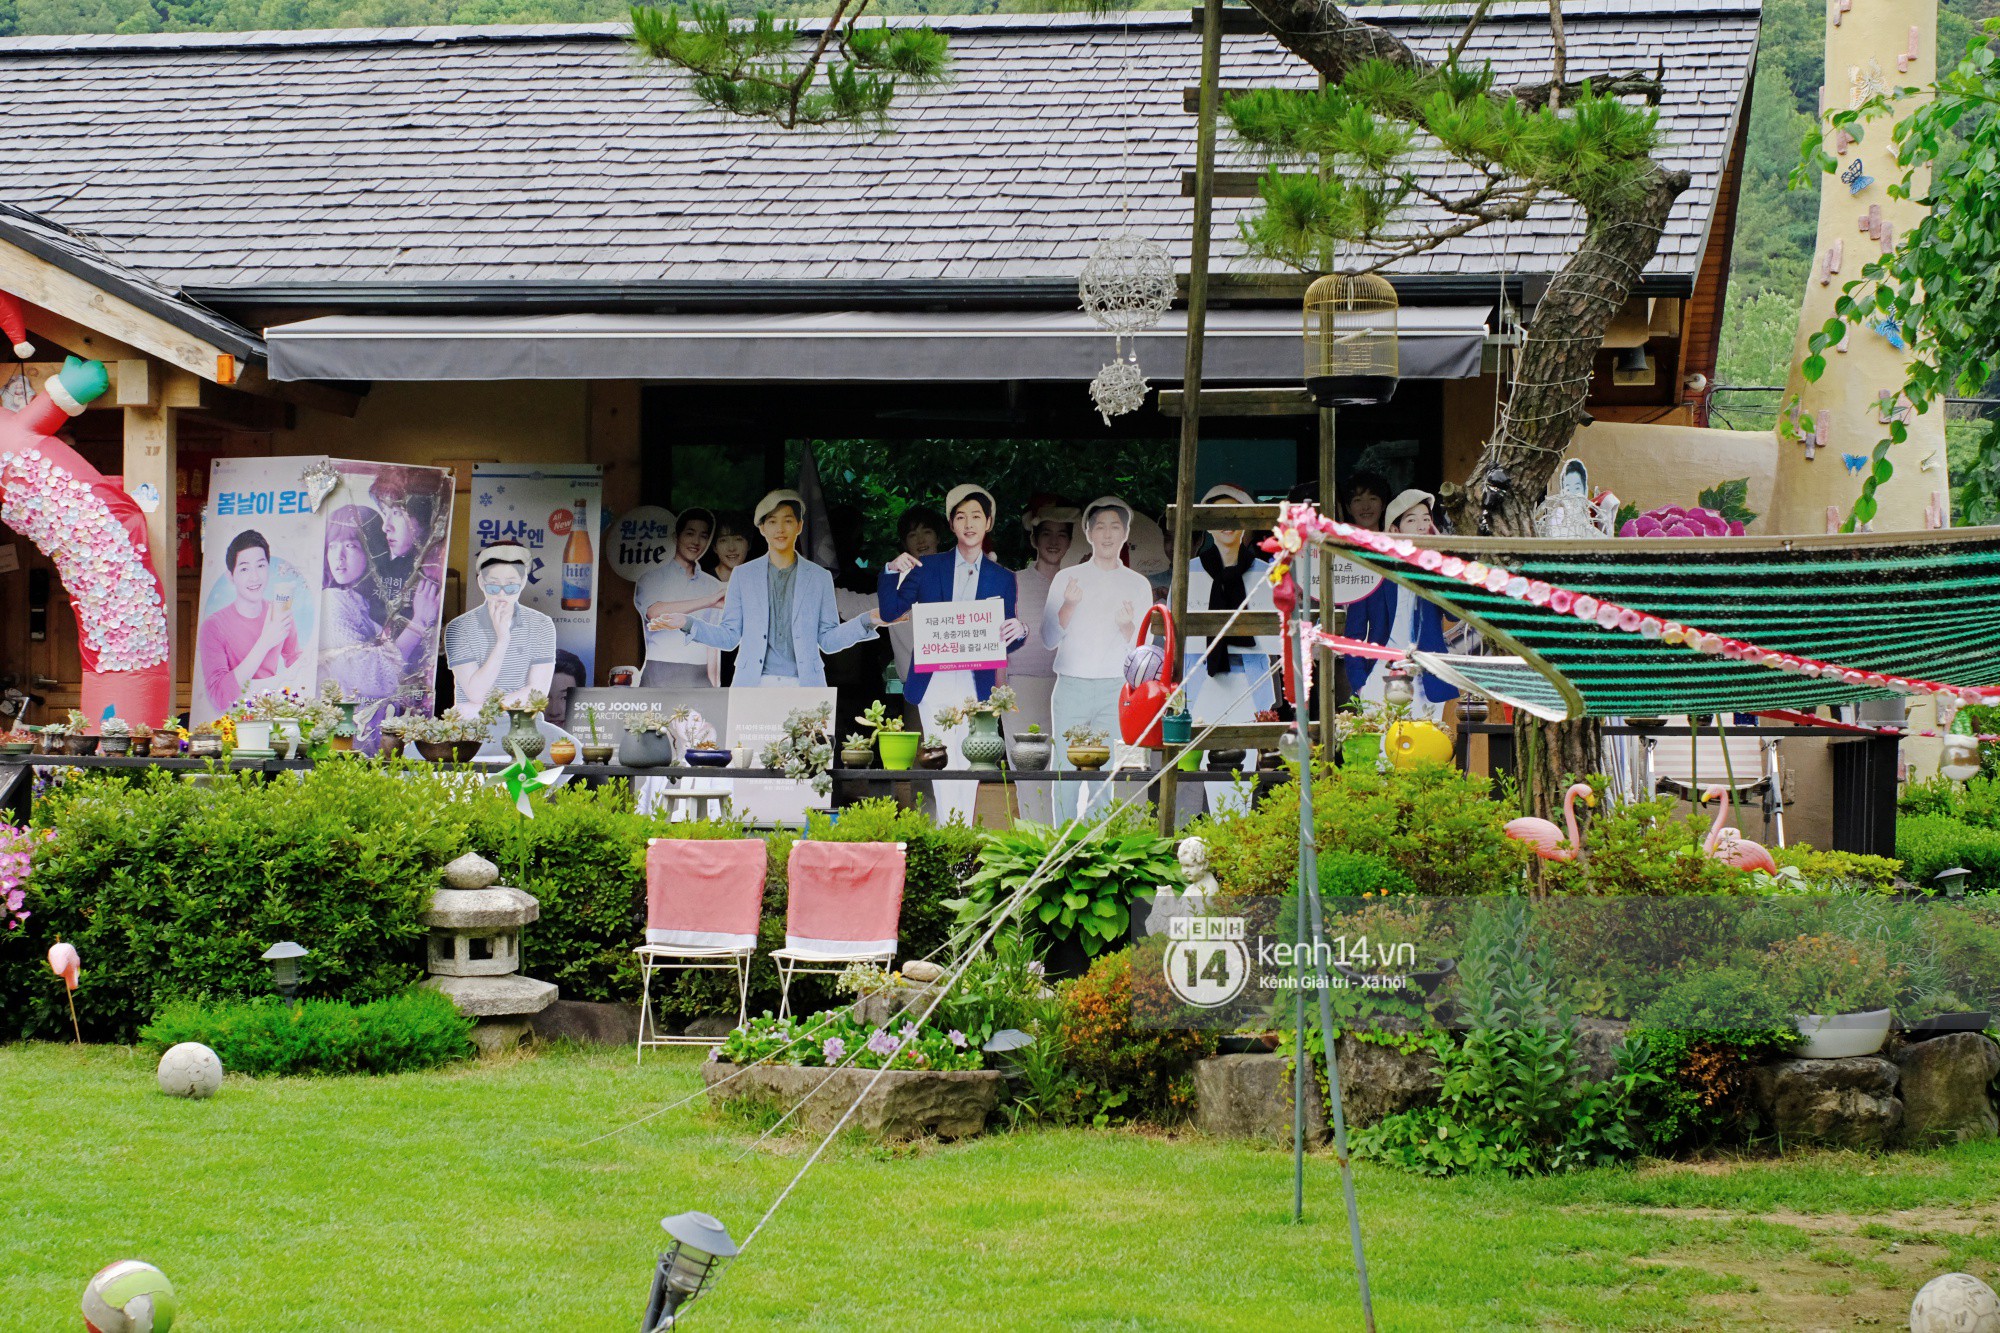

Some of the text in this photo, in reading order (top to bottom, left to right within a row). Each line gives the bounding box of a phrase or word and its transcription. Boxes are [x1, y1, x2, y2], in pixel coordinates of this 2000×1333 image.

[217, 491, 275, 516] 봄날이
[620, 520, 668, 540] 원샷엔
[619, 542, 666, 565] hite
[566, 564, 590, 578] hite
[925, 611, 992, 626] 지금 시각 밤 10시!
[932, 629, 987, 640] 저, 송중기와 함께
[922, 642, 999, 655] 심야쇼핑을 즐길 시간!
[608, 702, 648, 711] JOONG
[651, 702, 662, 711] KI
